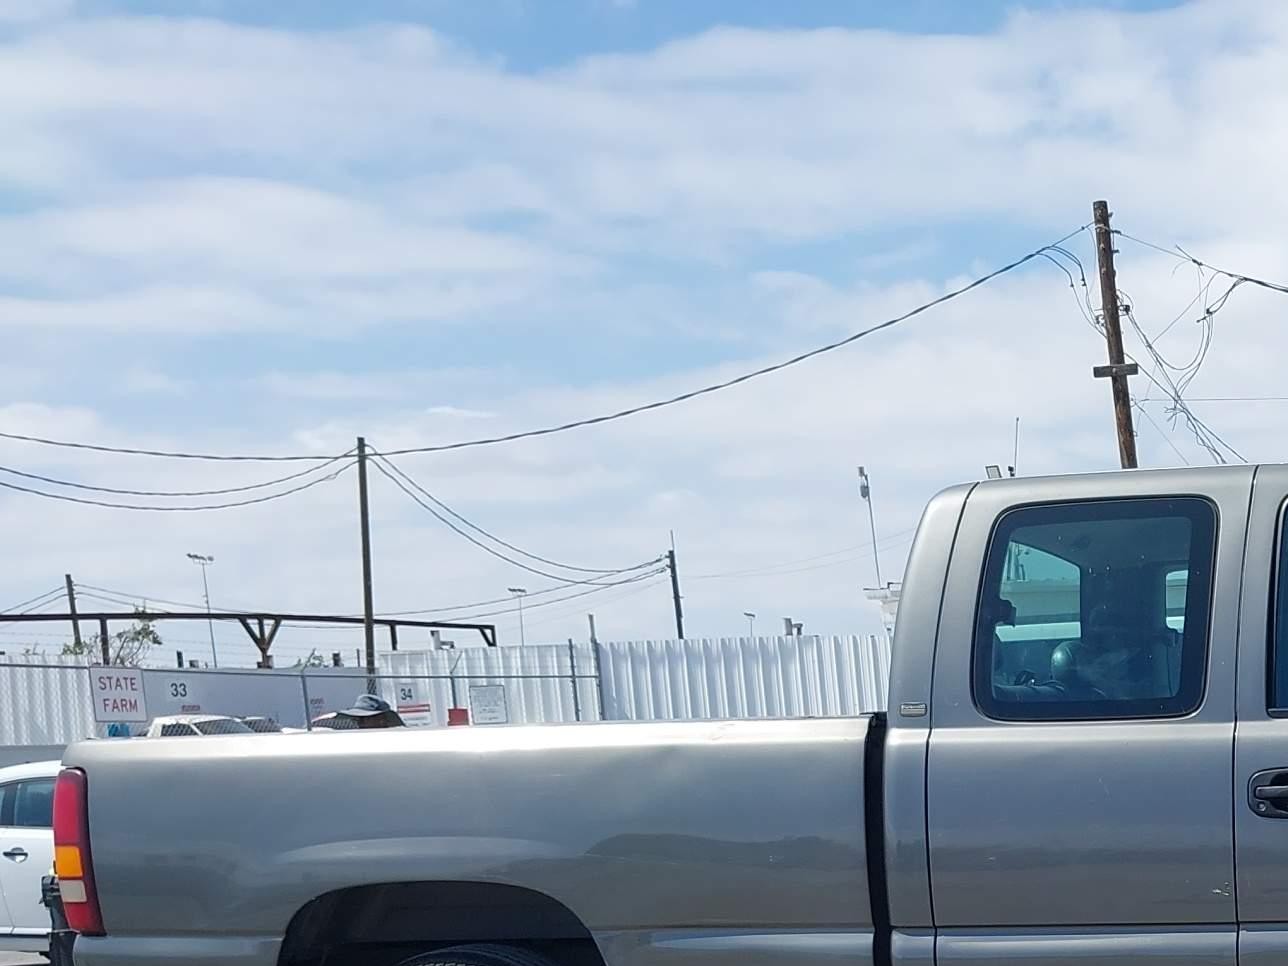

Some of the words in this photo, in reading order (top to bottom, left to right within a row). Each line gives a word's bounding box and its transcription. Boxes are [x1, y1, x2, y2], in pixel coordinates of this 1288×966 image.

[98, 676, 138, 691] STATE
[170, 683, 188, 697] 33
[400, 688, 412, 701] 34
[103, 698, 138, 712] FARM
